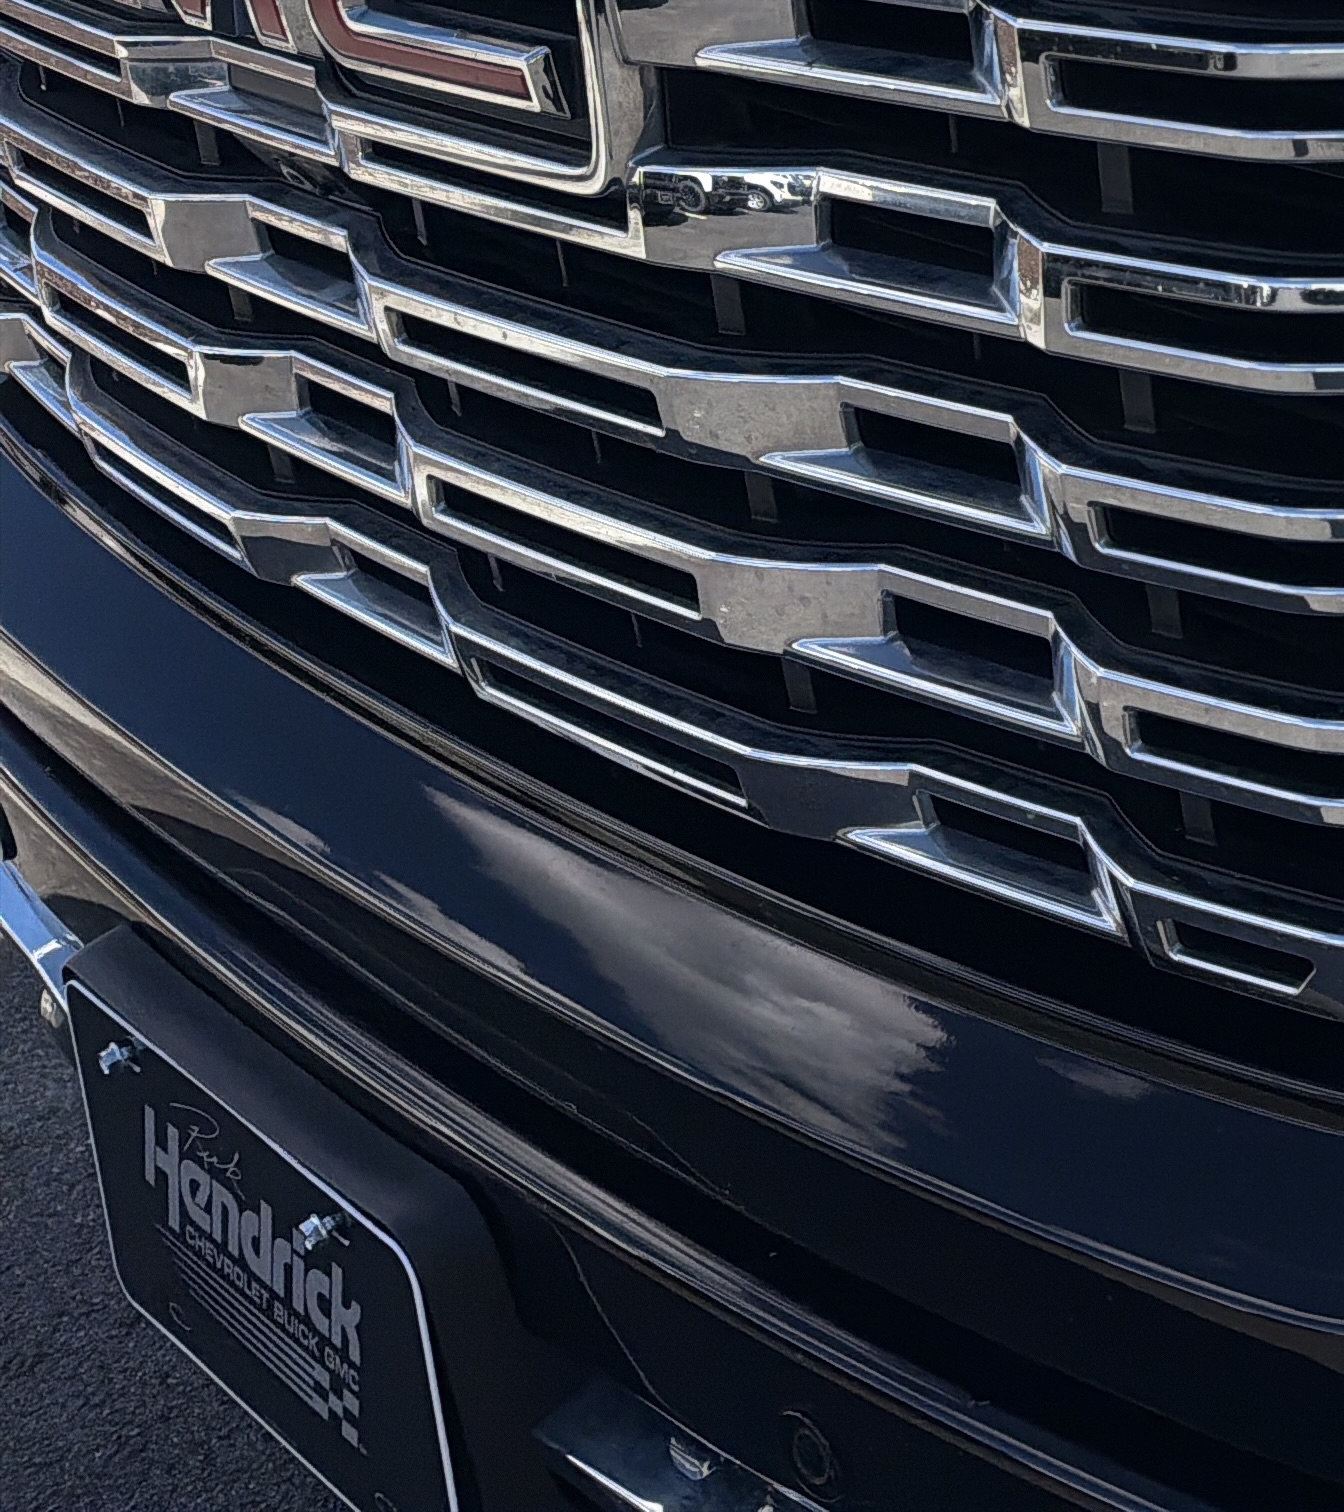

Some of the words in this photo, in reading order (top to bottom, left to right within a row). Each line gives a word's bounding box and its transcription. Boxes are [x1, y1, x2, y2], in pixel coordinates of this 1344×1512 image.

[143, 1104, 362, 1366] Hendrick
[184, 1224, 270, 1313] CHEVROLET
[272, 1299, 321, 1358] BUICK
[324, 1344, 361, 1392] GMC
